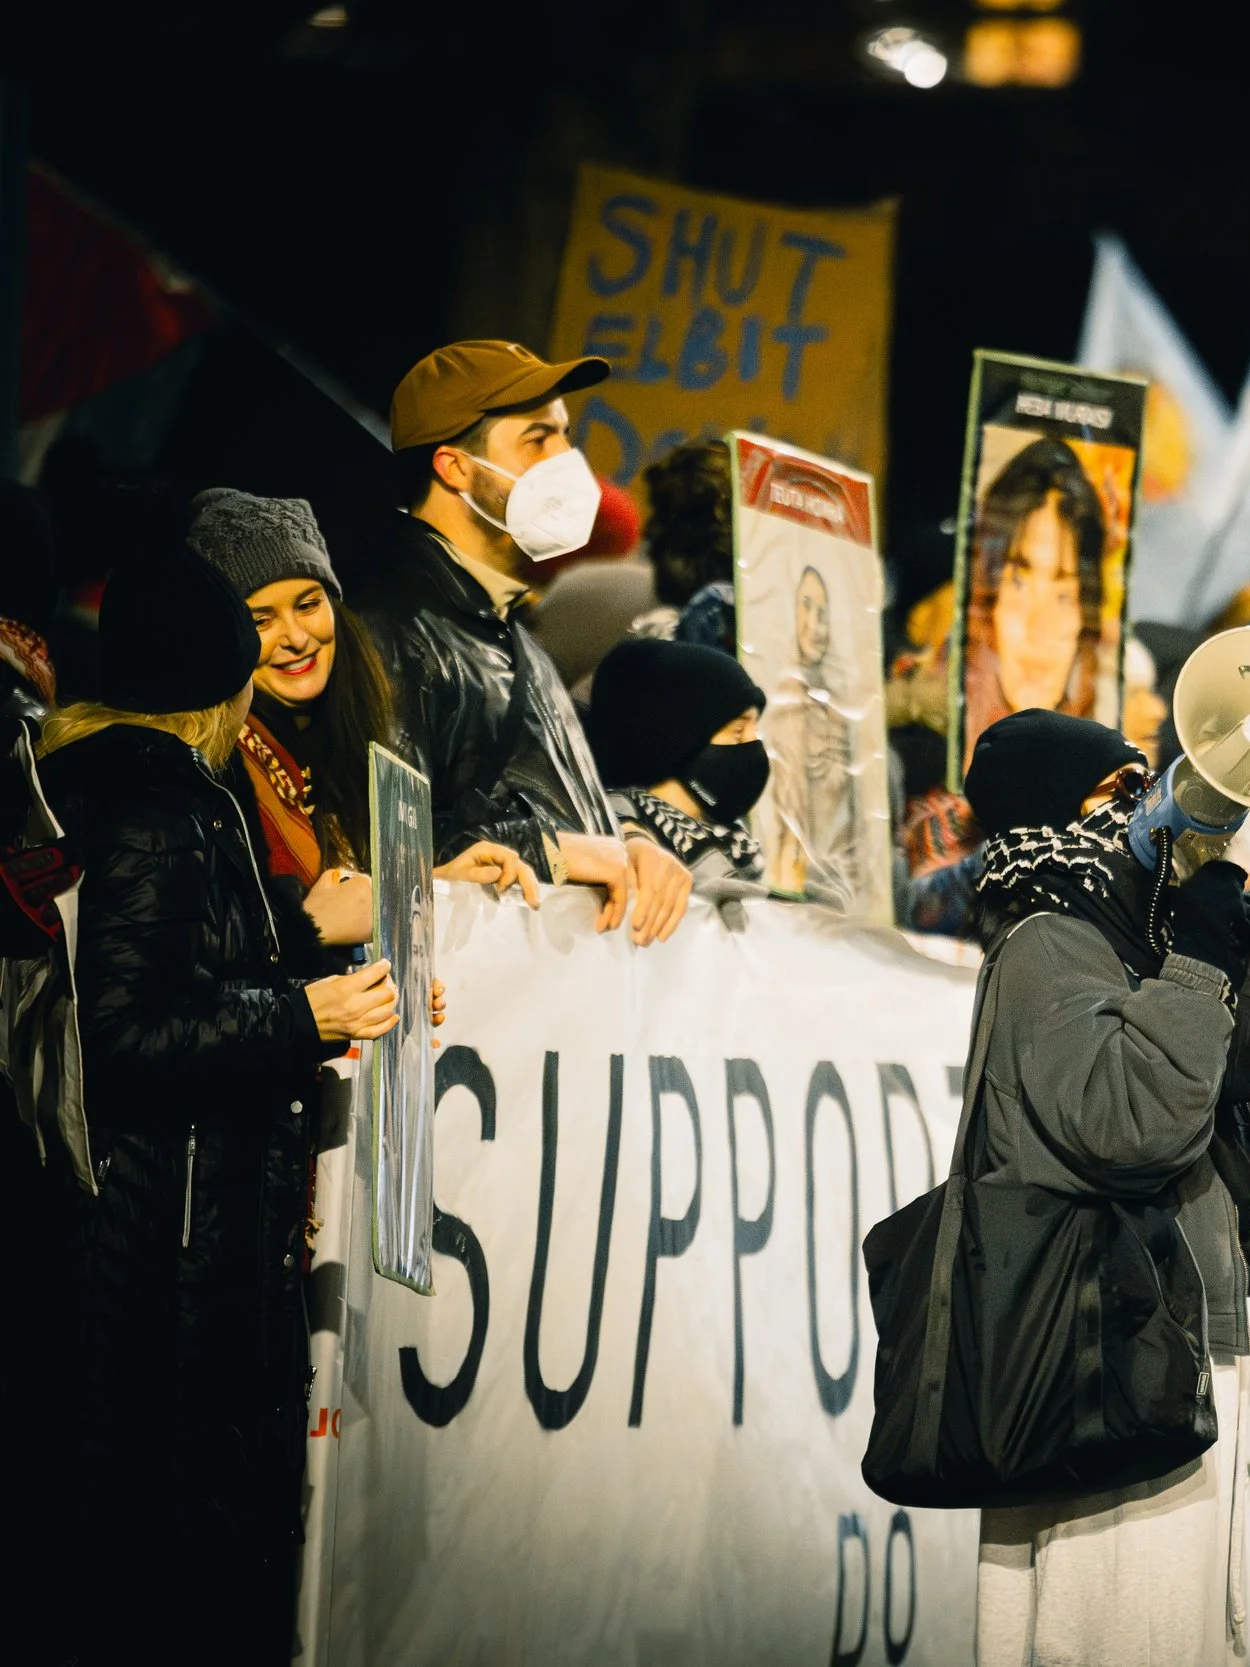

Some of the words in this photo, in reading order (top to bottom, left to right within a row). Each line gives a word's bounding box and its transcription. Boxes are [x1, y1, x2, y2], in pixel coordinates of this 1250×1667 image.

[586, 194, 849, 324] SHUT
[582, 304, 829, 402] ELBIT
[398, 1044, 965, 1430] SUPPO
